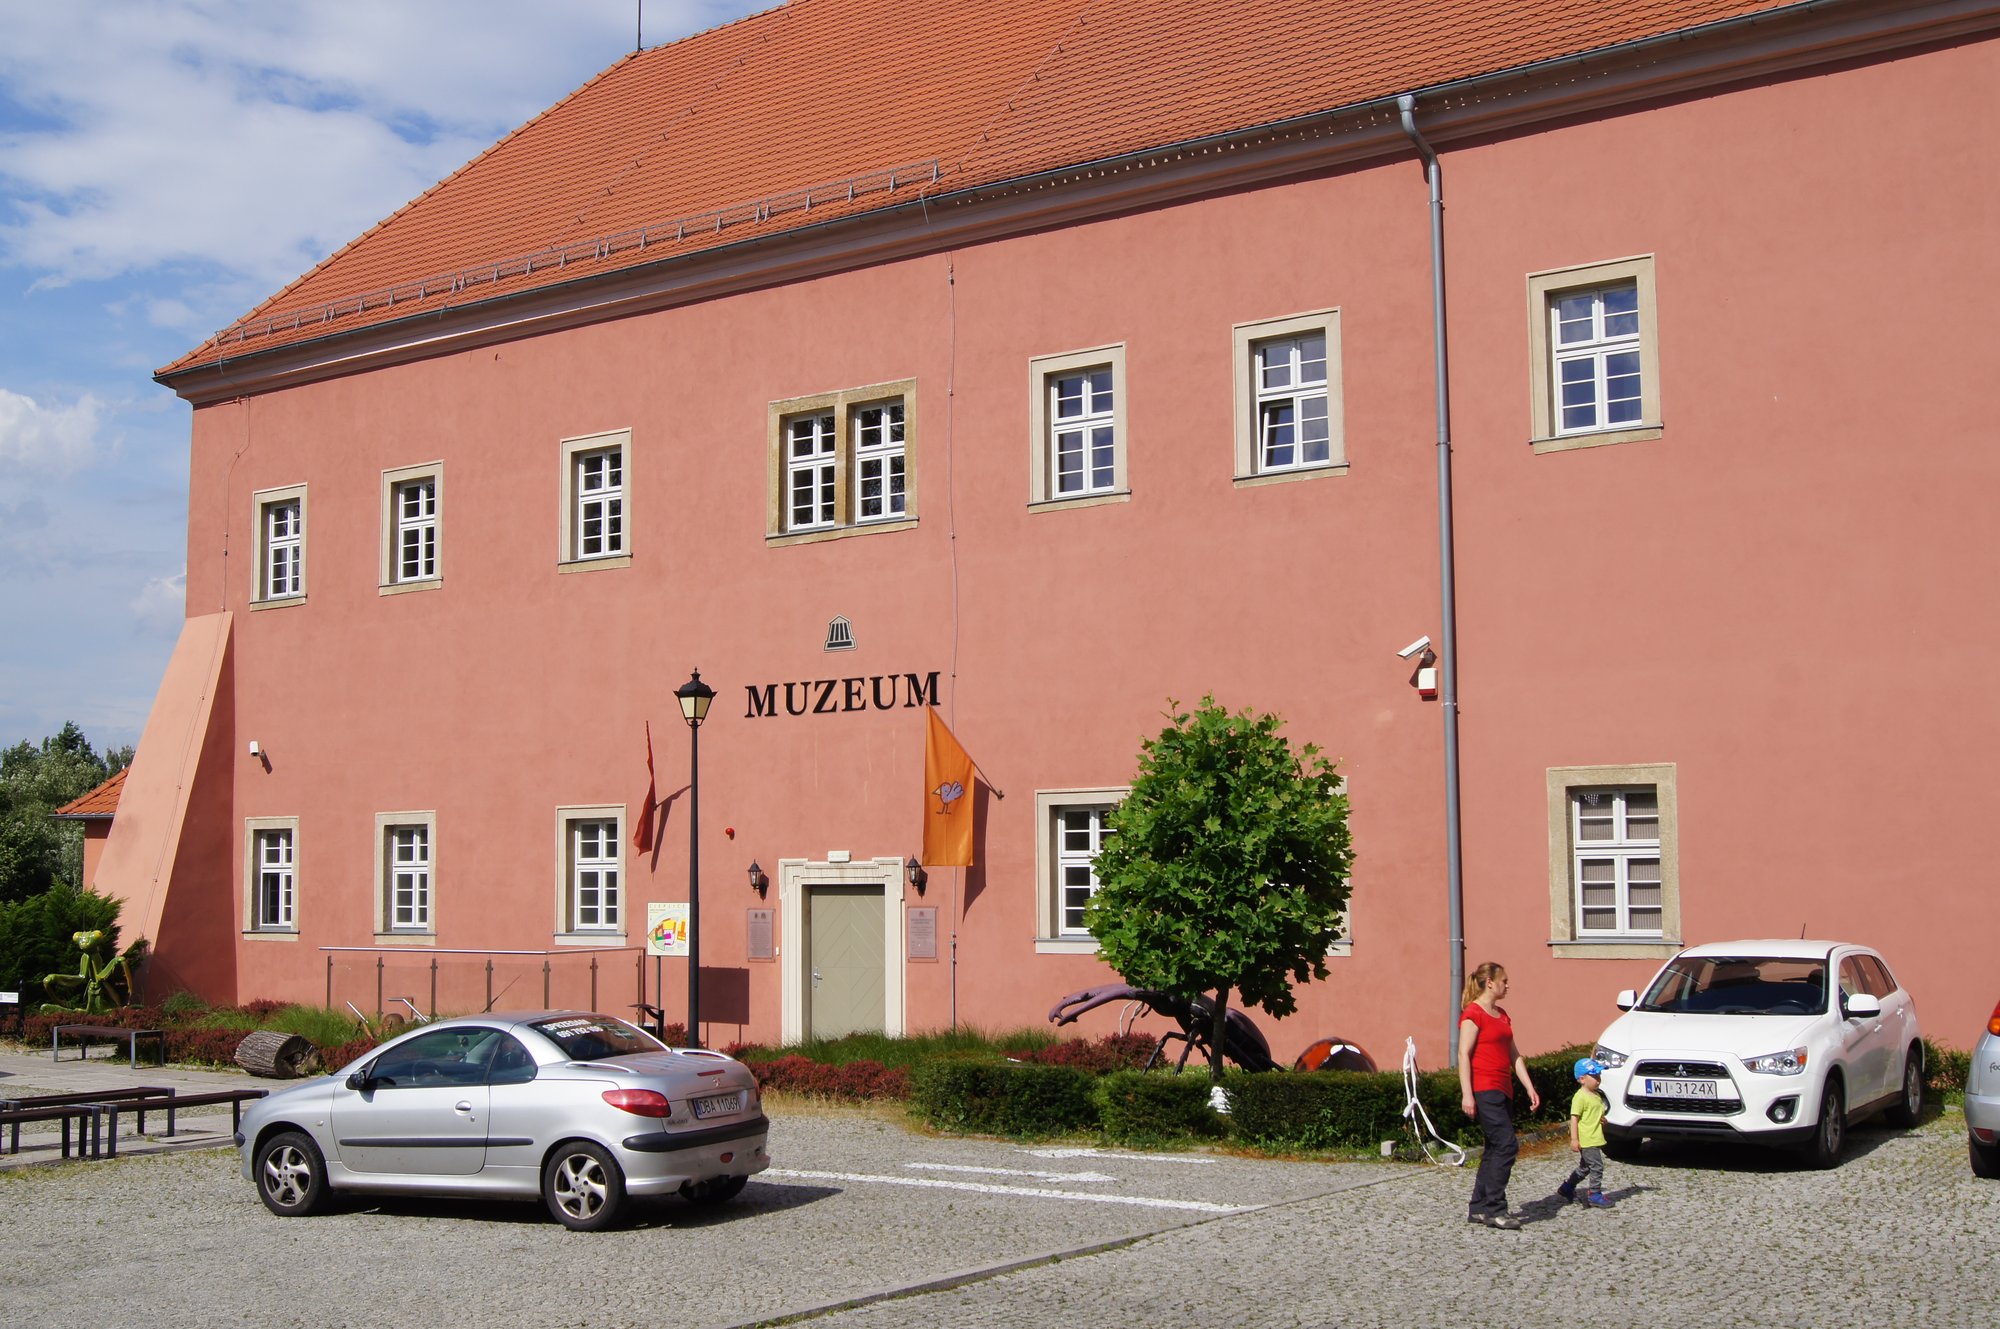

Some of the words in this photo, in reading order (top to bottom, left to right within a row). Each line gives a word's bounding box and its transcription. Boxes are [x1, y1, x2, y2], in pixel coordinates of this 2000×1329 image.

[744, 671, 941, 718] MUZEUM
[1653, 1082, 1669, 1093] WI
[1676, 1083, 1714, 1095] 3124X
[700, 1100, 717, 1114] DBA
